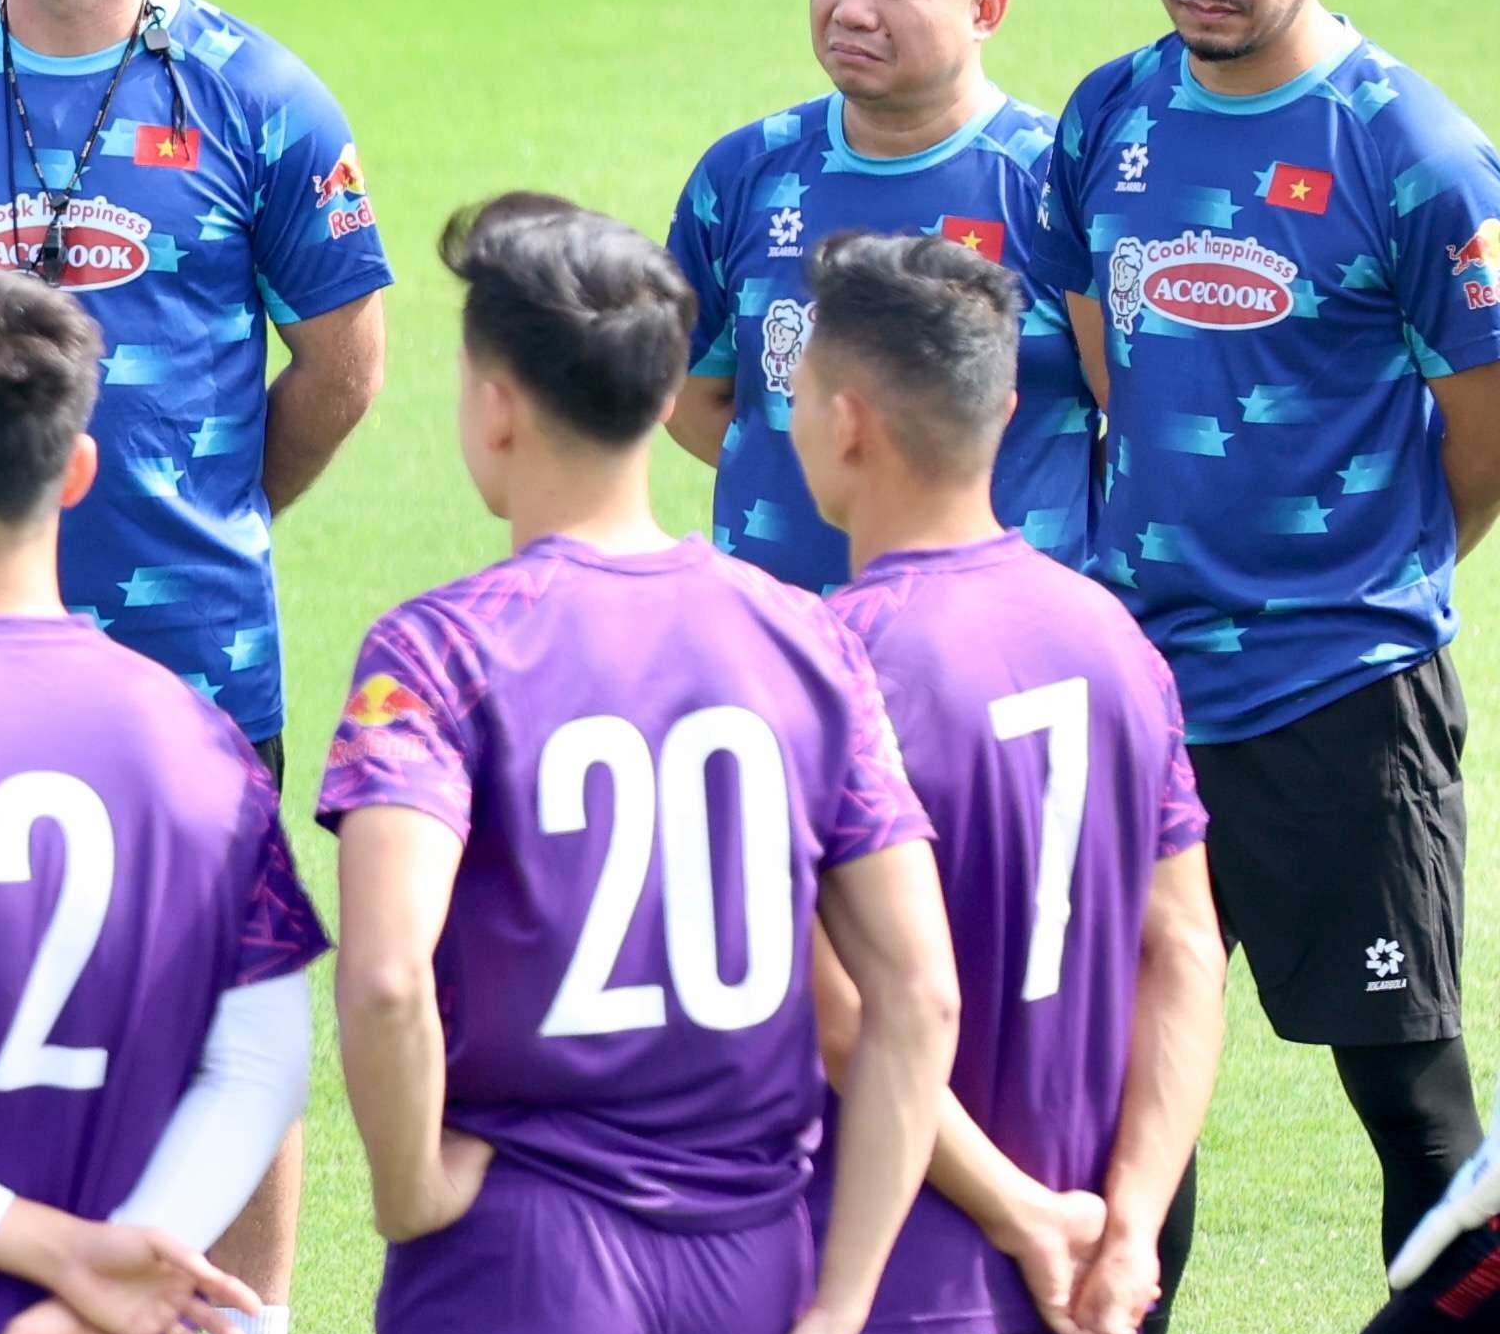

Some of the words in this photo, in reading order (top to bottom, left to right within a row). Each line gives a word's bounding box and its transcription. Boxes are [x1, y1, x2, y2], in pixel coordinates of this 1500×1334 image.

[43, 198, 147, 235] hppiness
[329, 197, 375, 239] Red
[1147, 236, 1197, 263] Cook
[1204, 235, 1293, 279] happiness
[988, 676, 1090, 1003] 7
[538, 704, 795, 1037] 20
